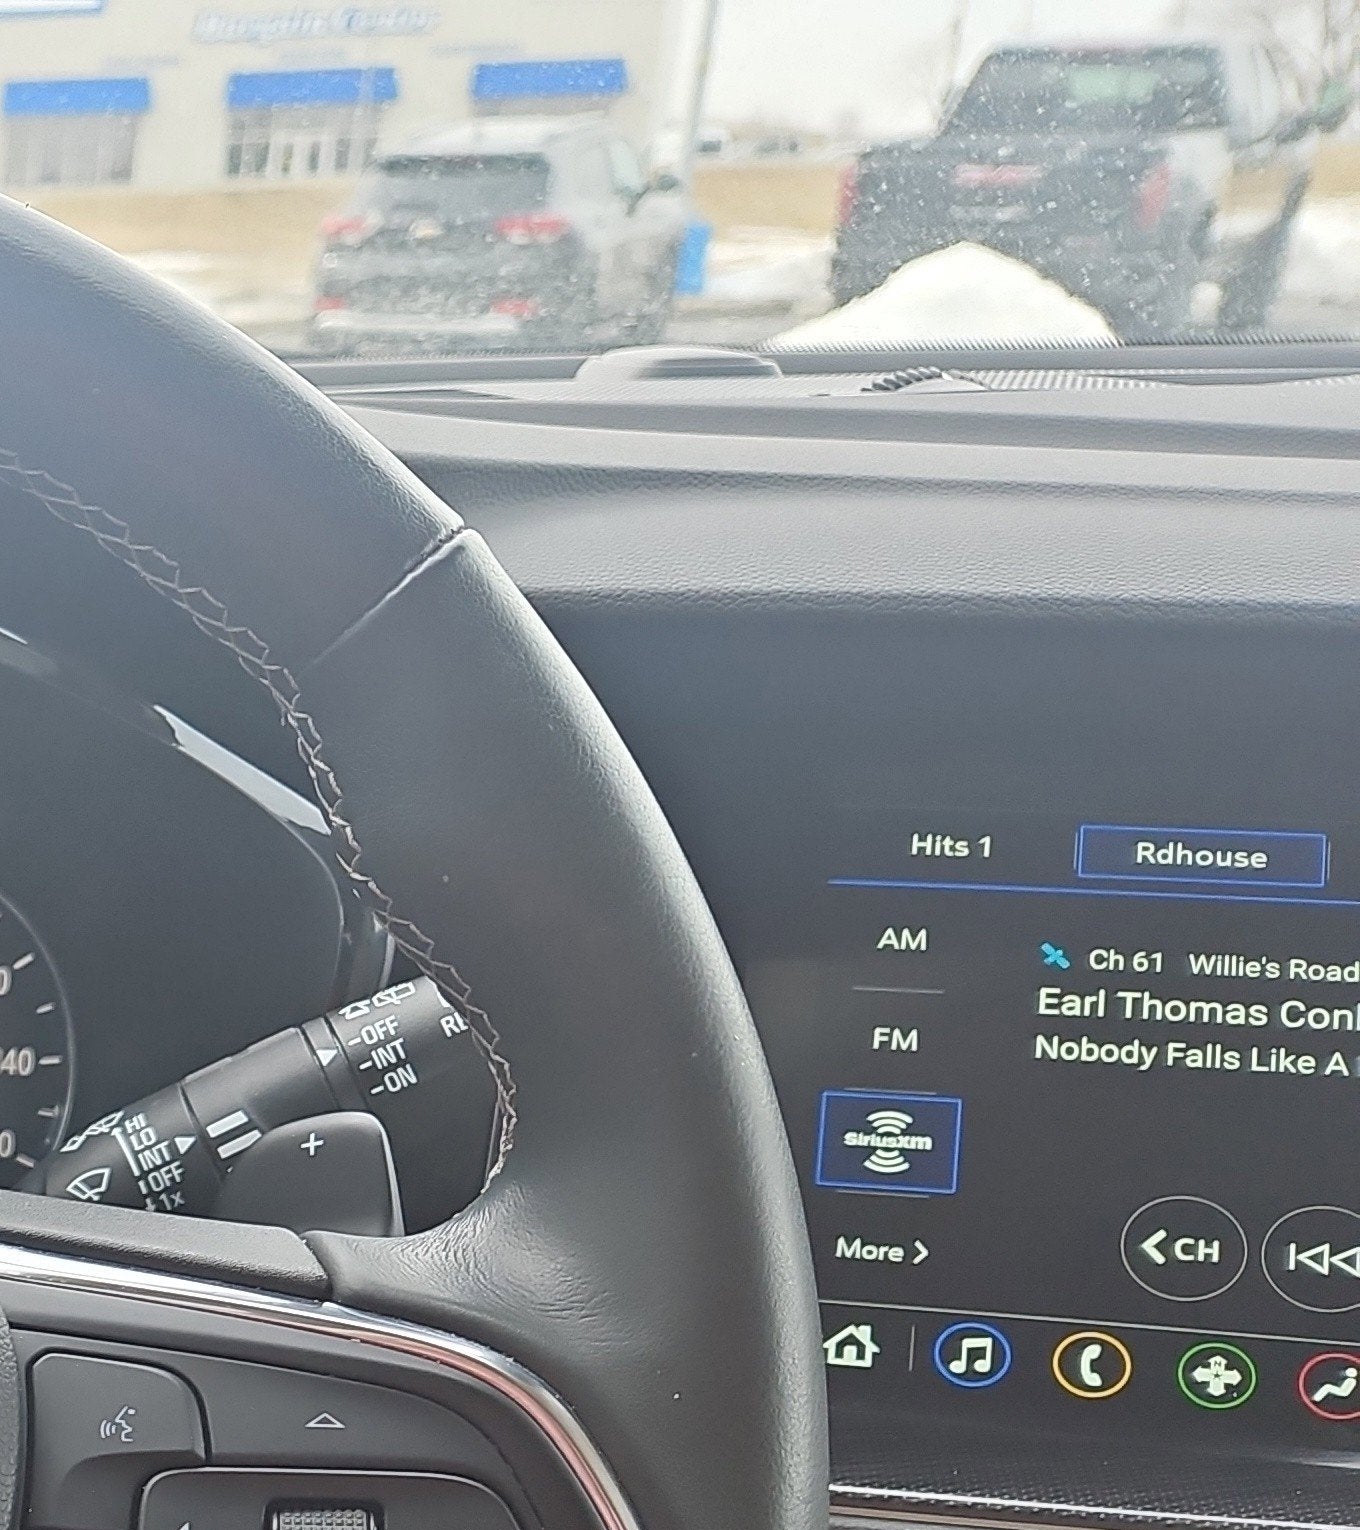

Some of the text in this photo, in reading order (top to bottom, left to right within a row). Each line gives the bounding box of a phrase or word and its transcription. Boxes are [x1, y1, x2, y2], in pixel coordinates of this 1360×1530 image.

[910, 833, 992, 858] Hits 1
[1136, 841, 1268, 870] Rdhouse
[877, 928, 928, 952] AM
[1088, 948, 1126, 972] Ch
[1132, 951, 1164, 973] 61
[1189, 953, 1281, 980] Willie's
[1037, 987, 1106, 1019] Earl
[1117, 990, 1268, 1028] Thomas
[360, 1016, 401, 1046] OFF
[872, 1027, 919, 1052] FM
[371, 1038, 407, 1070] INT
[1034, 1034, 1350, 1077] Nobody Falls Like A
[382, 1063, 418, 1094] ON
[125, 1112, 148, 1133] HI
[132, 1126, 157, 1151] LO
[137, 1142, 172, 1168] INT
[148, 1164, 185, 1195] OFF
[834, 1236, 905, 1264] More
[1173, 1237, 1221, 1264] CH
